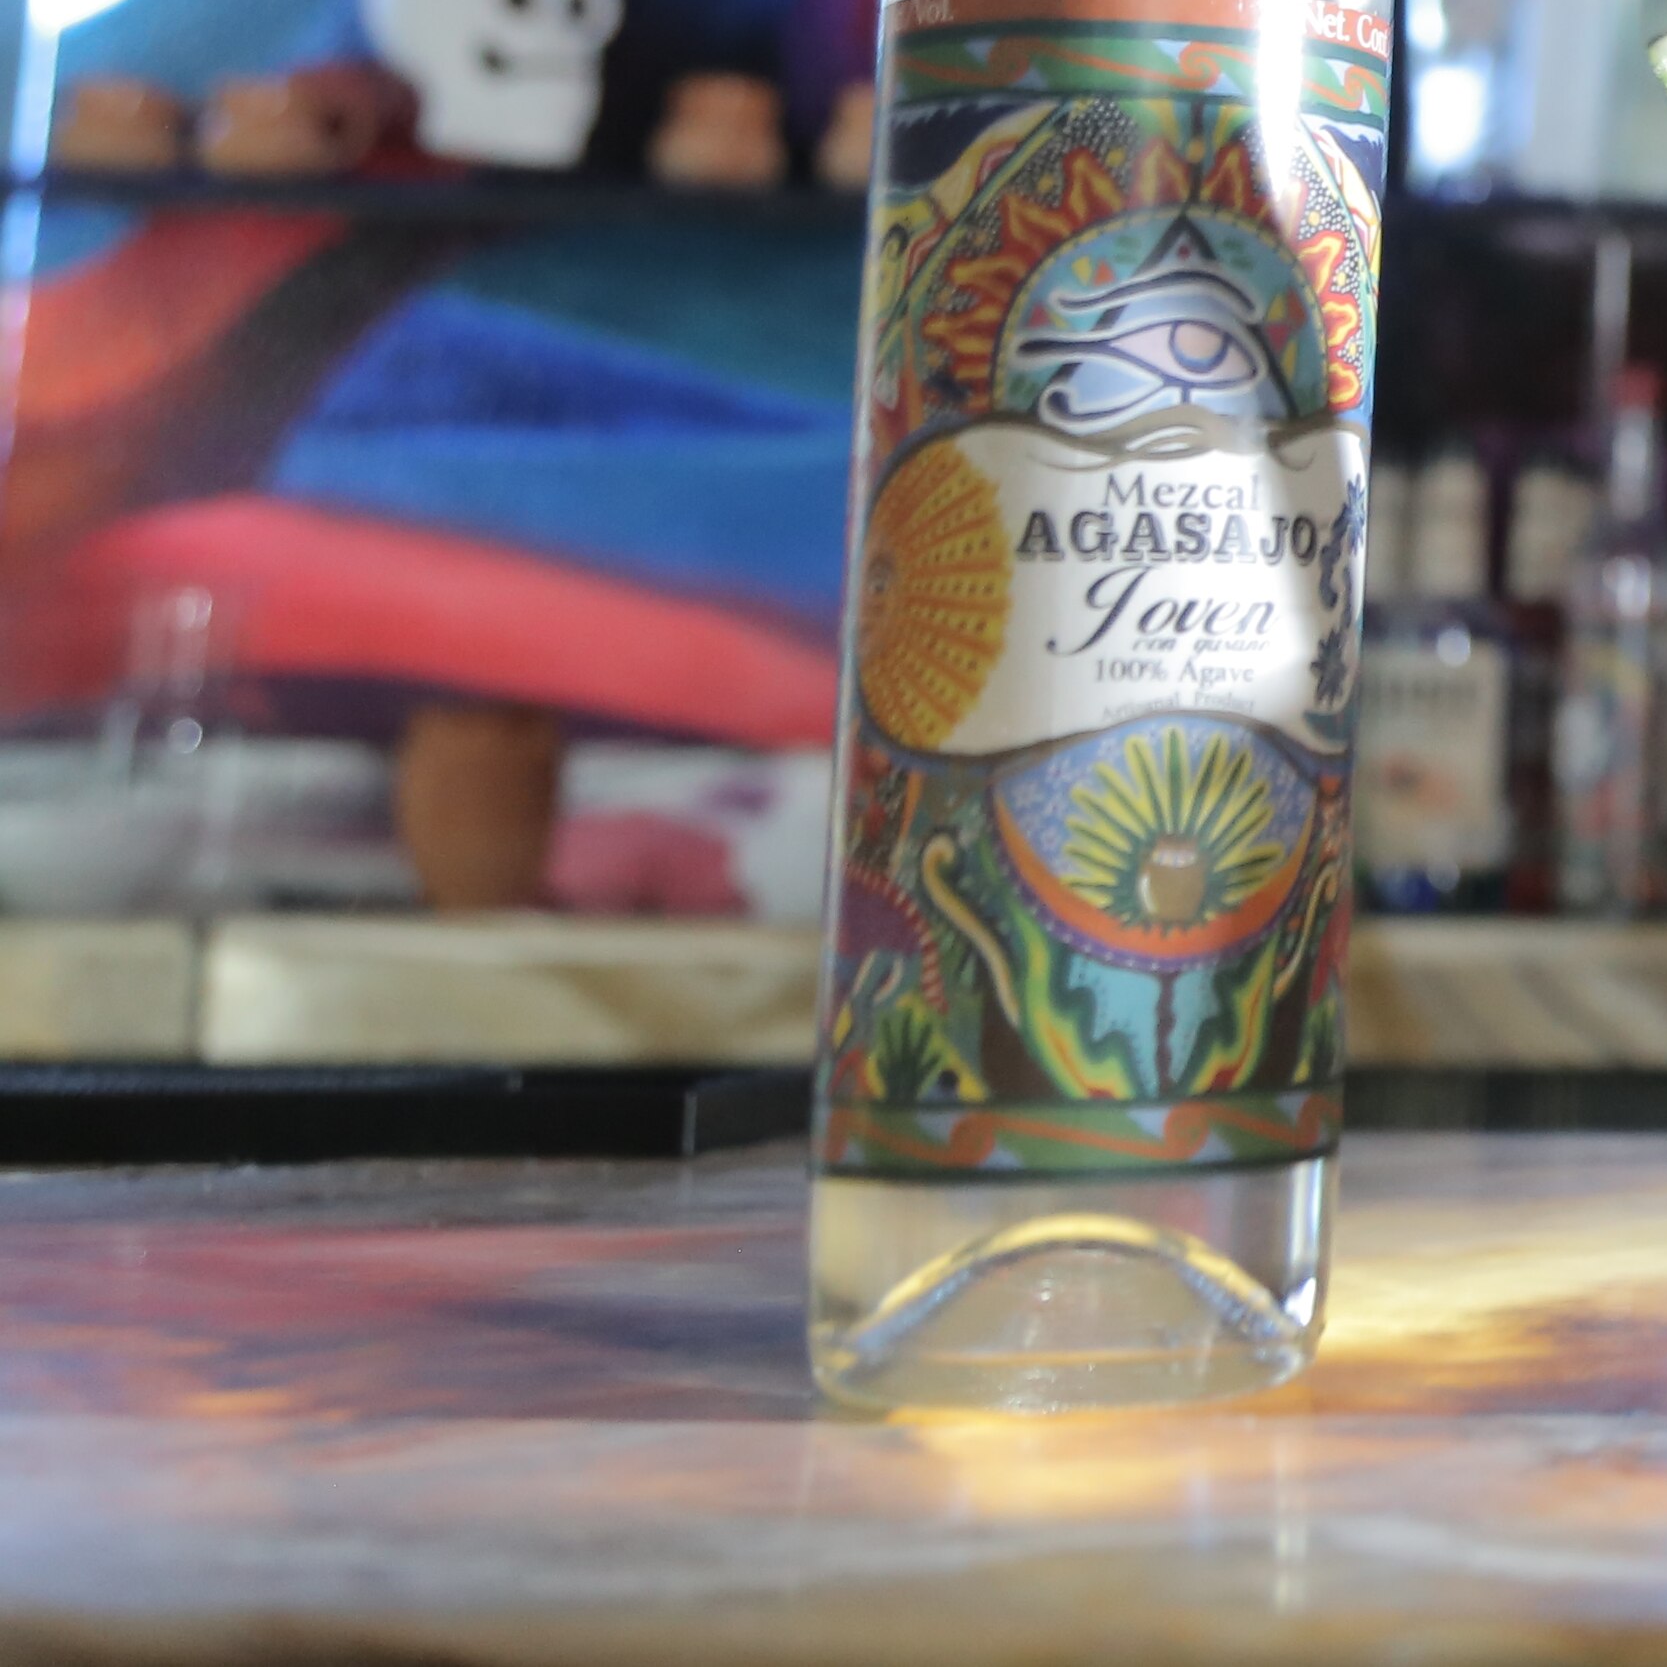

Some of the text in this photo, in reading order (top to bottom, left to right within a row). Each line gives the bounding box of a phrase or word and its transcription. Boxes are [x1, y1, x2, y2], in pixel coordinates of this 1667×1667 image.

[1101, 471, 1260, 511] Mezcal
[1016, 509, 1318, 566] AGASAJO
[1046, 563, 1280, 657] Joven
[1095, 656, 1255, 688] 100% Agave
